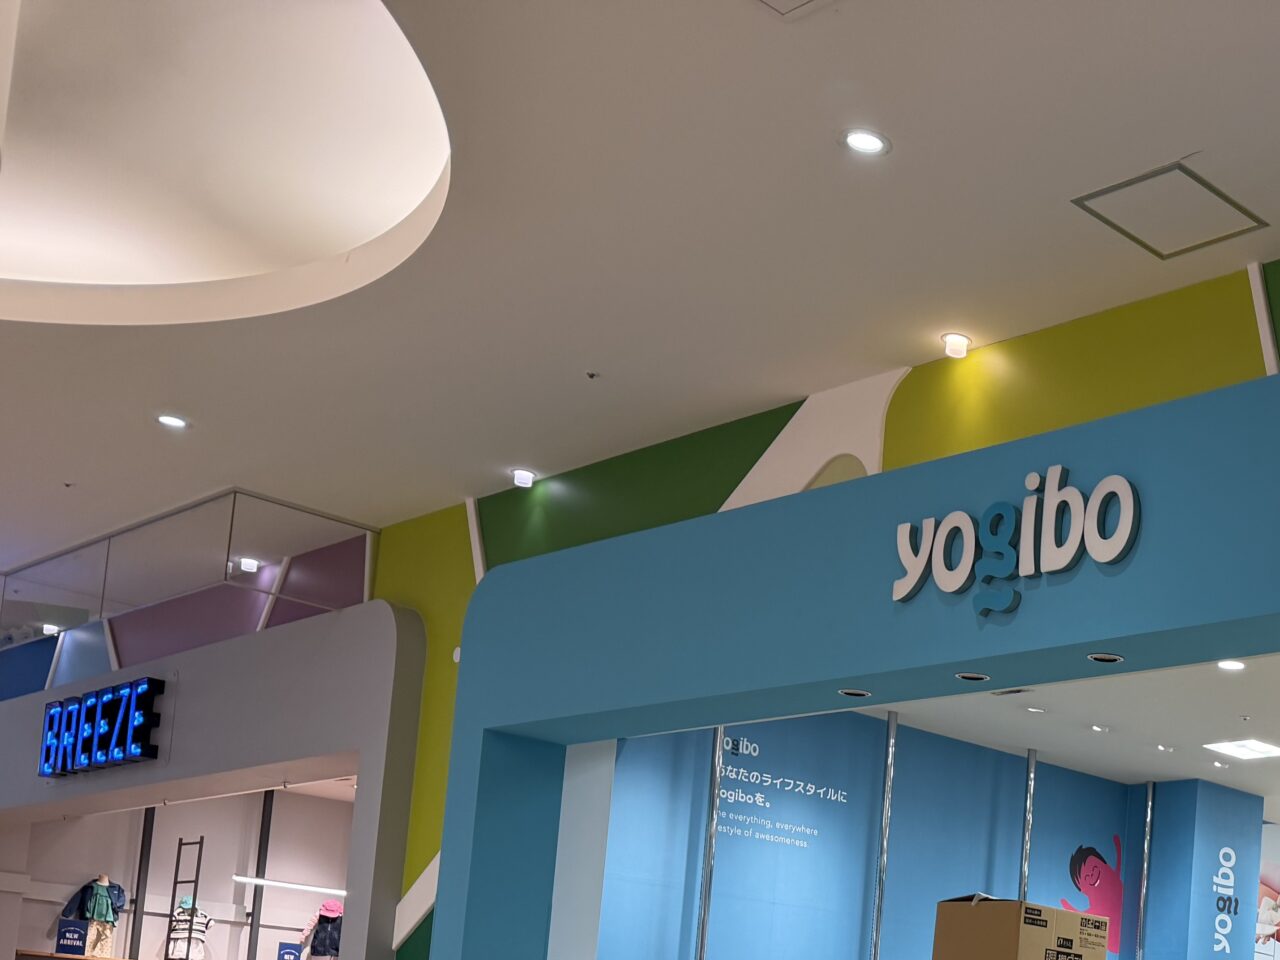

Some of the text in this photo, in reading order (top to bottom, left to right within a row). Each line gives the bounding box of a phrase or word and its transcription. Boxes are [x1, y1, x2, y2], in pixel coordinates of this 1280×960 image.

[893, 464, 1139, 615] yogibo
[38, 677, 164, 778] BREEZE
[723, 736, 760, 757] ogibo
[720, 785, 771, 808] ogiboを。
[744, 828, 753, 837] of
[776, 821, 818, 836] everywhere
[1213, 846, 1239, 954] yogibo
